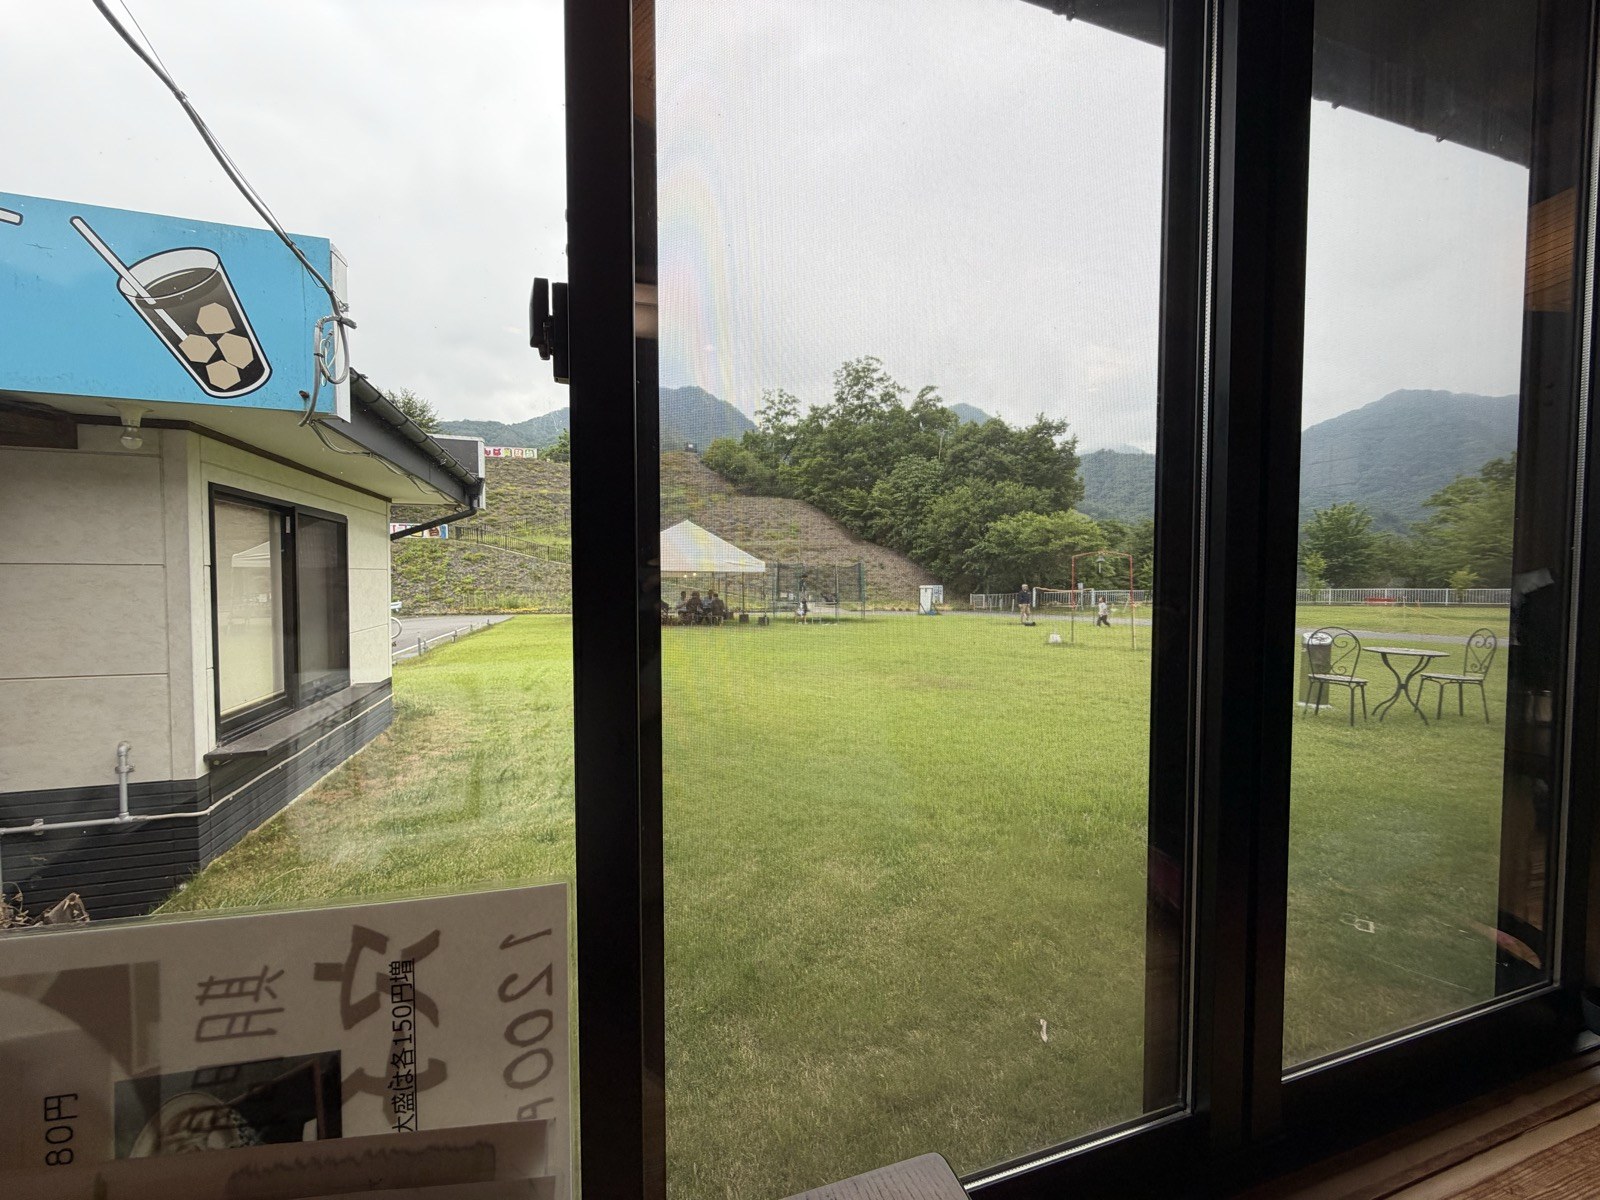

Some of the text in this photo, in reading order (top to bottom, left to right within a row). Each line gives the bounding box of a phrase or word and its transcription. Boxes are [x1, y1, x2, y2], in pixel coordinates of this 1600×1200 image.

[388, 959, 415, 1132] 大盛は各150円増
